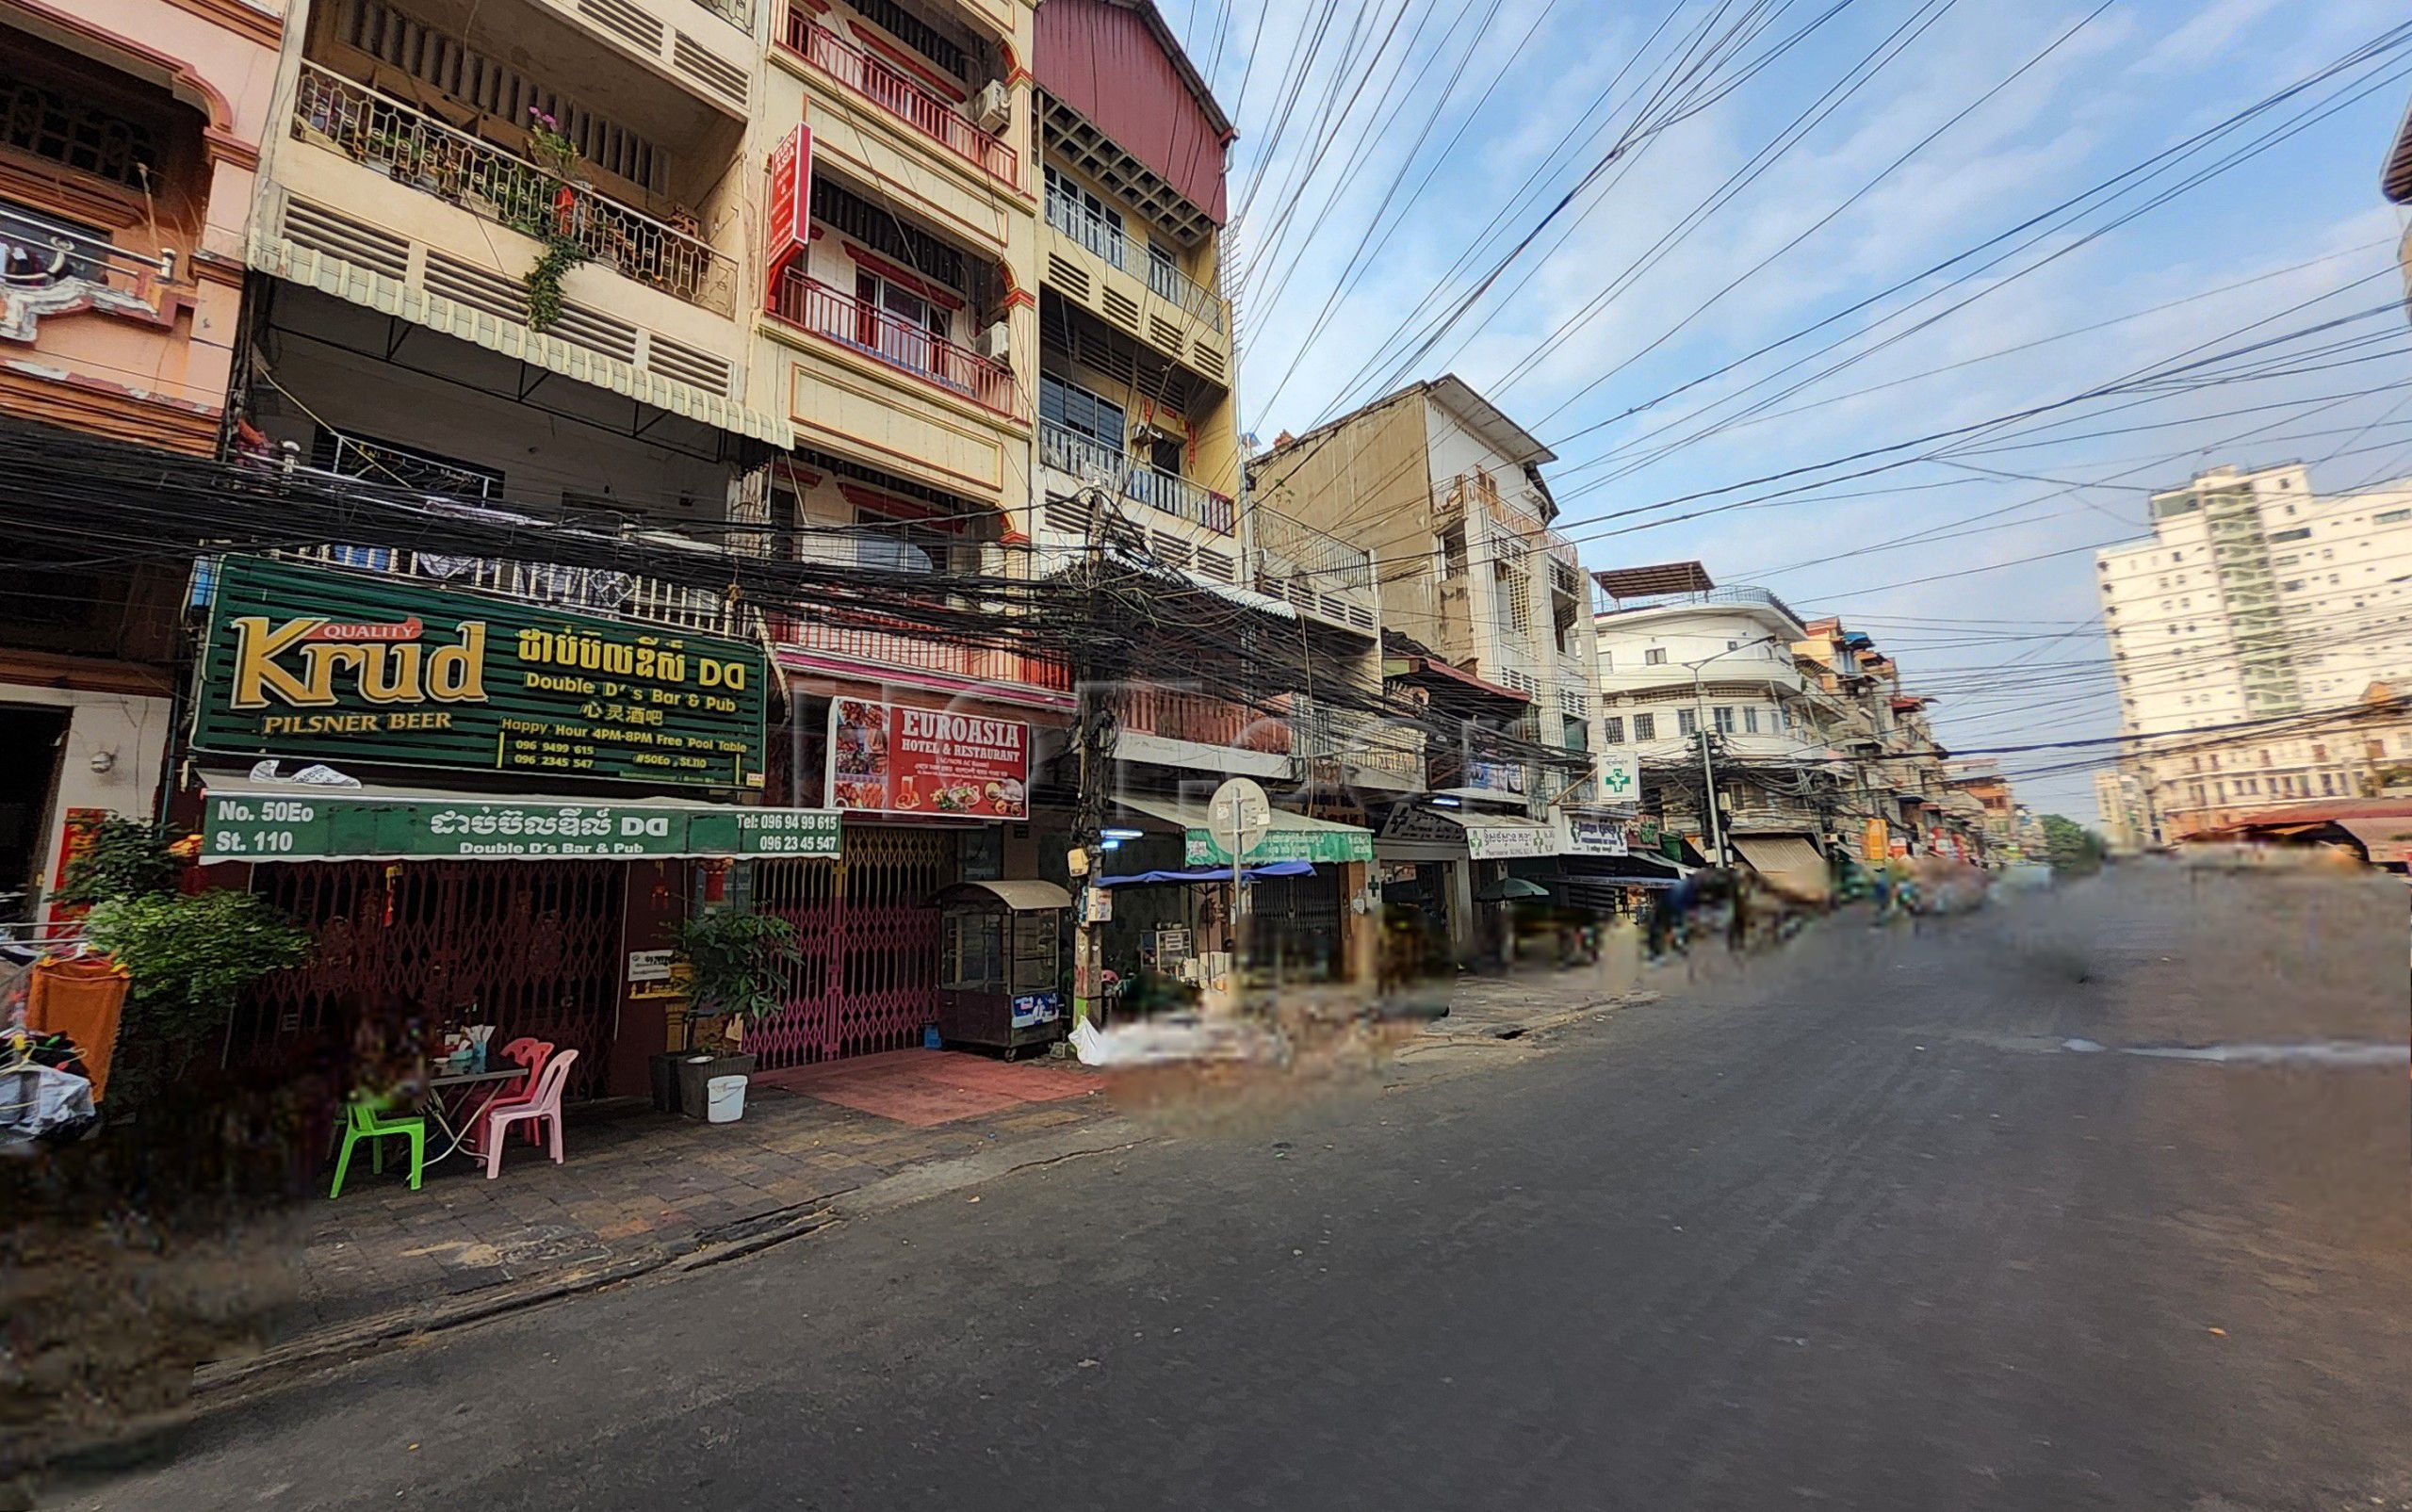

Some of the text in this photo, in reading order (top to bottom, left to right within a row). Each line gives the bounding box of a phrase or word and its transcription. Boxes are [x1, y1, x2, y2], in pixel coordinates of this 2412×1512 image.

[323, 625, 415, 640] QUALITY
[230, 616, 489, 710] Krud
[526, 672, 595, 695] Double
[651, 689, 681, 706] Bar
[687, 693, 699, 707] &
[706, 695, 737, 712] Pub
[263, 712, 452, 735] PILSNER BEER
[581, 700, 663, 726] 心灵酒吧
[501, 718, 747, 753] Happy Hour 4PM-8PM Free Pool Table
[902, 709, 1020, 748] EUROASIA
[515, 740, 595, 755] 096 9499 615
[901, 738, 1020, 762] HOTEL & RESTAURANT
[513, 754, 594, 769] 096 2345 547
[635, 754, 671, 766] #50Eo
[218, 800, 315, 822] No. 50Eo
[736, 814, 837, 830] Tel: 096 94 99 615
[215, 831, 293, 852] St. 110
[459, 842, 525, 854] Double
[562, 842, 593, 854] Bar
[595, 842, 609, 854] &
[613, 842, 644, 854] Pub
[759, 836, 837, 851] 096 23 45 547
